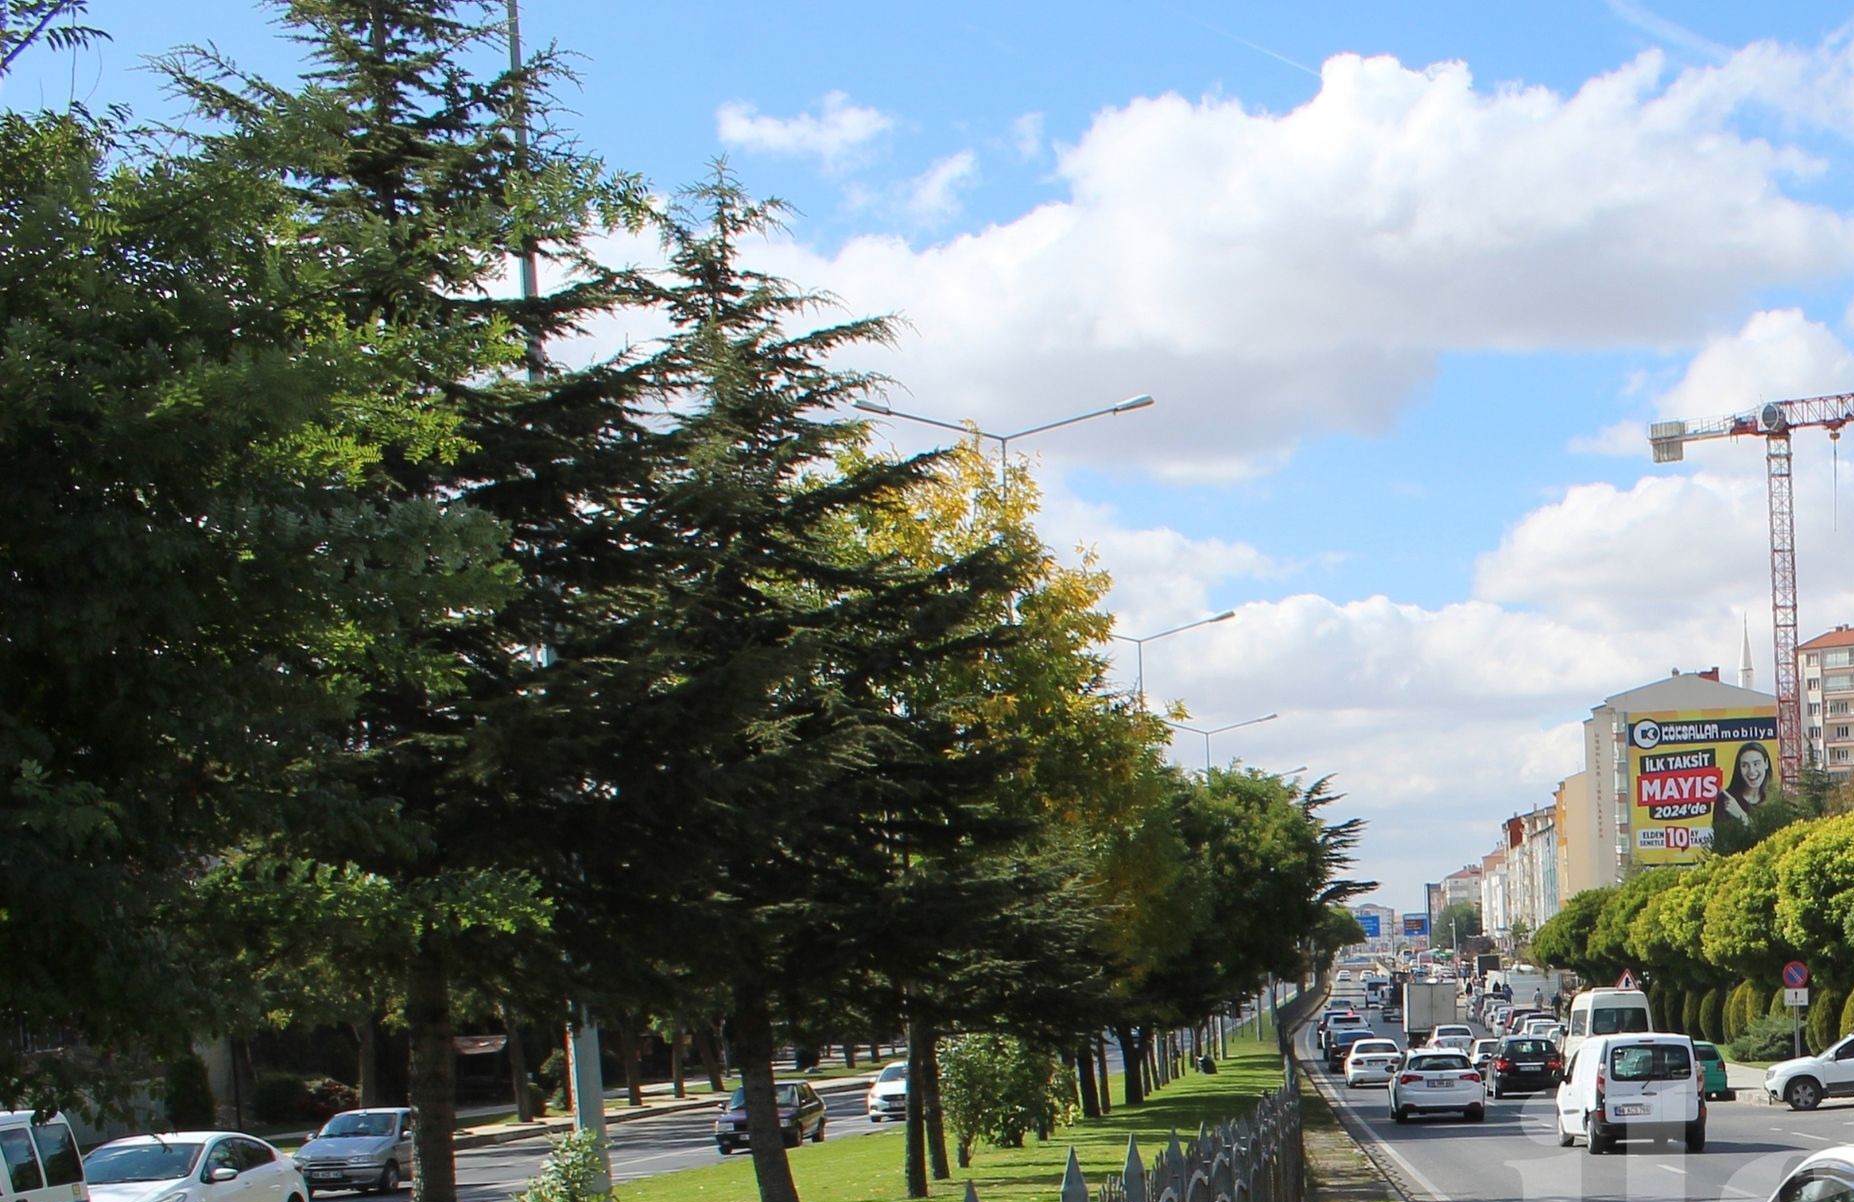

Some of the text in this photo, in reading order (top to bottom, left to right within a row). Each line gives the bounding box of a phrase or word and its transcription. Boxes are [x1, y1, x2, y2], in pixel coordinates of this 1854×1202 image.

[1661, 724, 1719, 742] KÖKSALLAR
[1721, 727, 1774, 739] mobilya
[1645, 752, 1710, 772] İLK TAKSİT
[1641, 775, 1718, 802] MAYIS
[1653, 802, 1707, 819] 2024'de
[1642, 831, 1665, 839] ELDEN
[1666, 827, 1688, 847] 10
